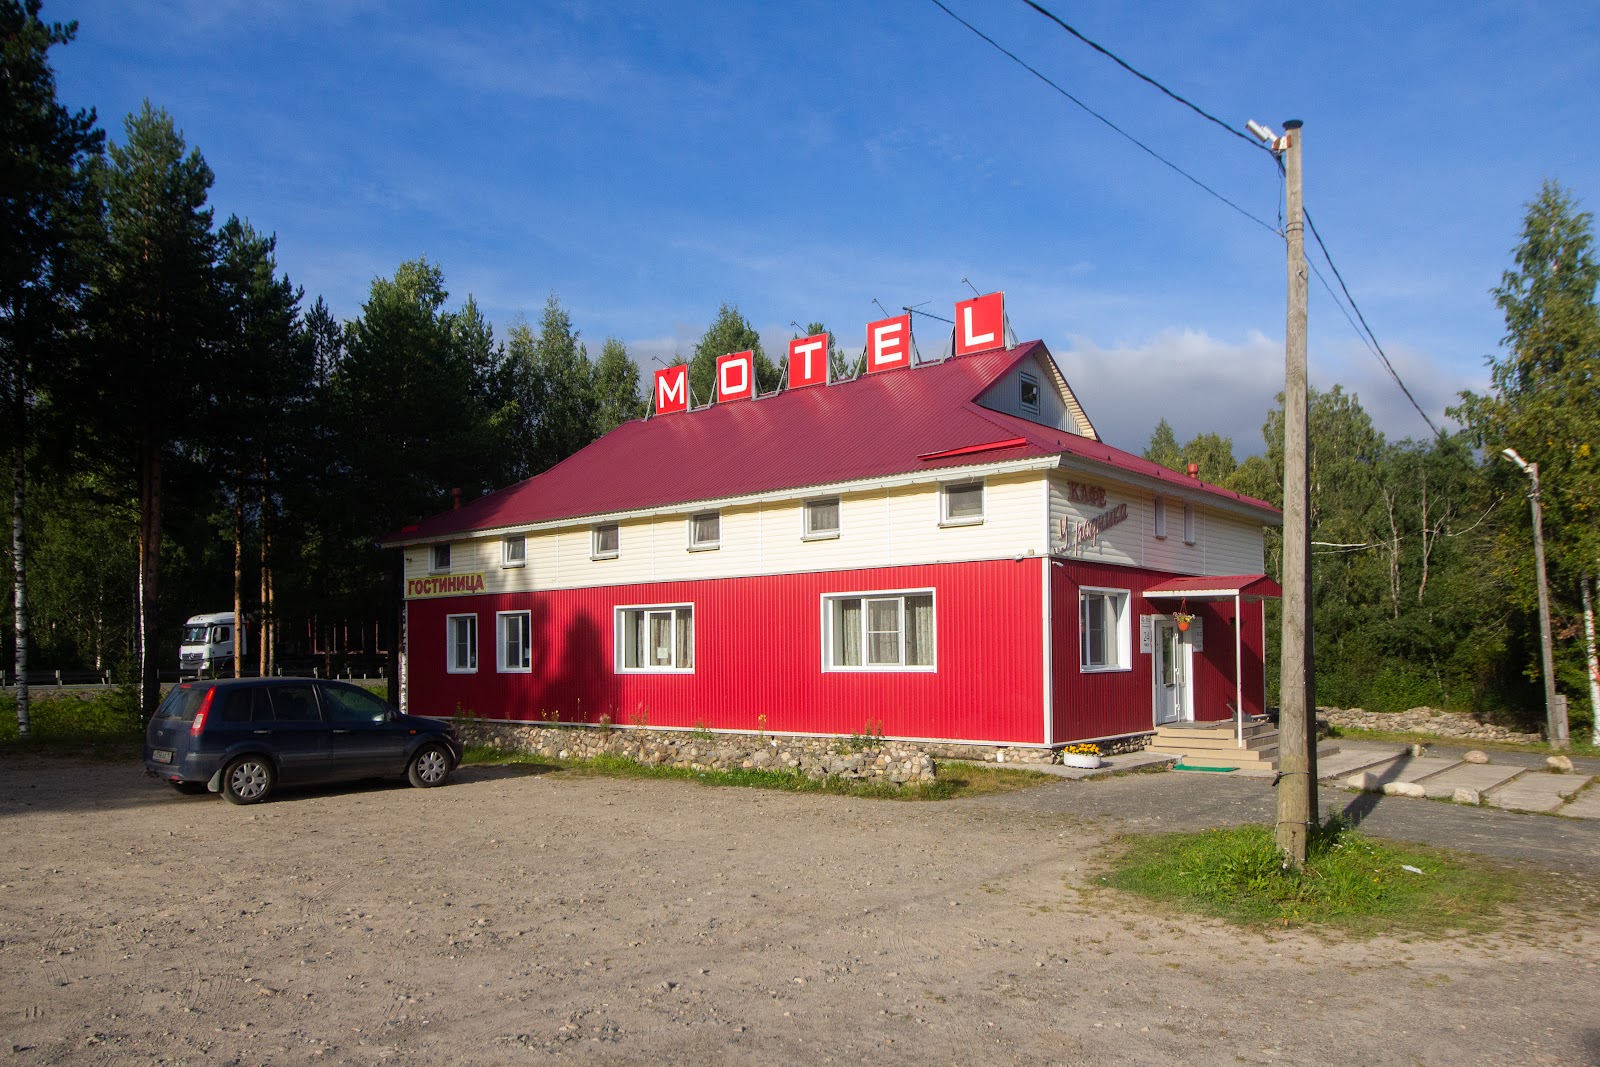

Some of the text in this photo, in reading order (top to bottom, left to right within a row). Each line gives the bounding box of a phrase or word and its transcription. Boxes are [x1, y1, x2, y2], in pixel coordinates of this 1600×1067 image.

[658, 306, 995, 409] MOTEL
[1067, 481, 1107, 508] КАФЕ
[408, 574, 485, 596] ГОСТИНИЦА
